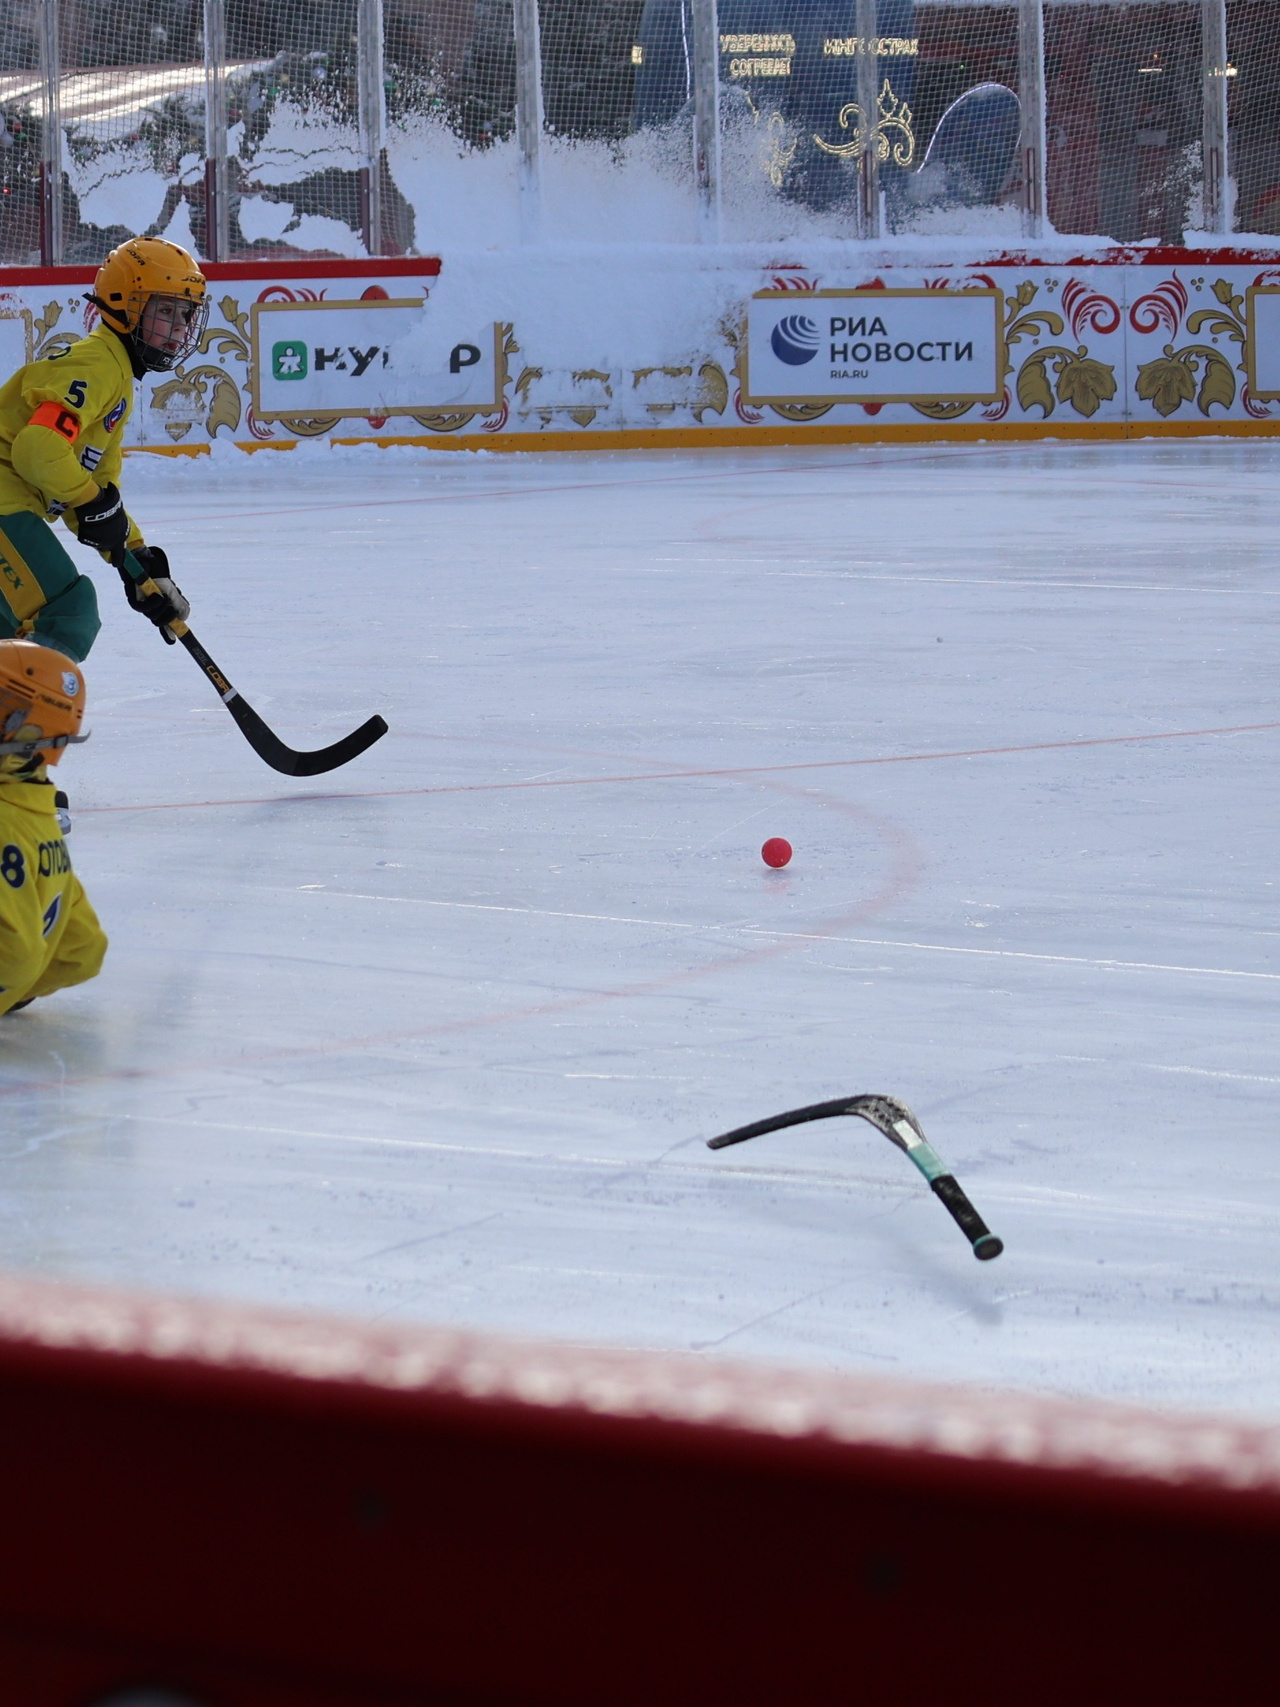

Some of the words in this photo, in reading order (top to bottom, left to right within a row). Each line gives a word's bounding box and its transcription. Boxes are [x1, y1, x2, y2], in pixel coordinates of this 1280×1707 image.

[829, 316, 888, 337] РИА
[829, 341, 973, 362] НОВОСТИ
[830, 369, 869, 379] RIA.RU
[64, 379, 88, 410] 5
[0, 843, 26, 889] 8
